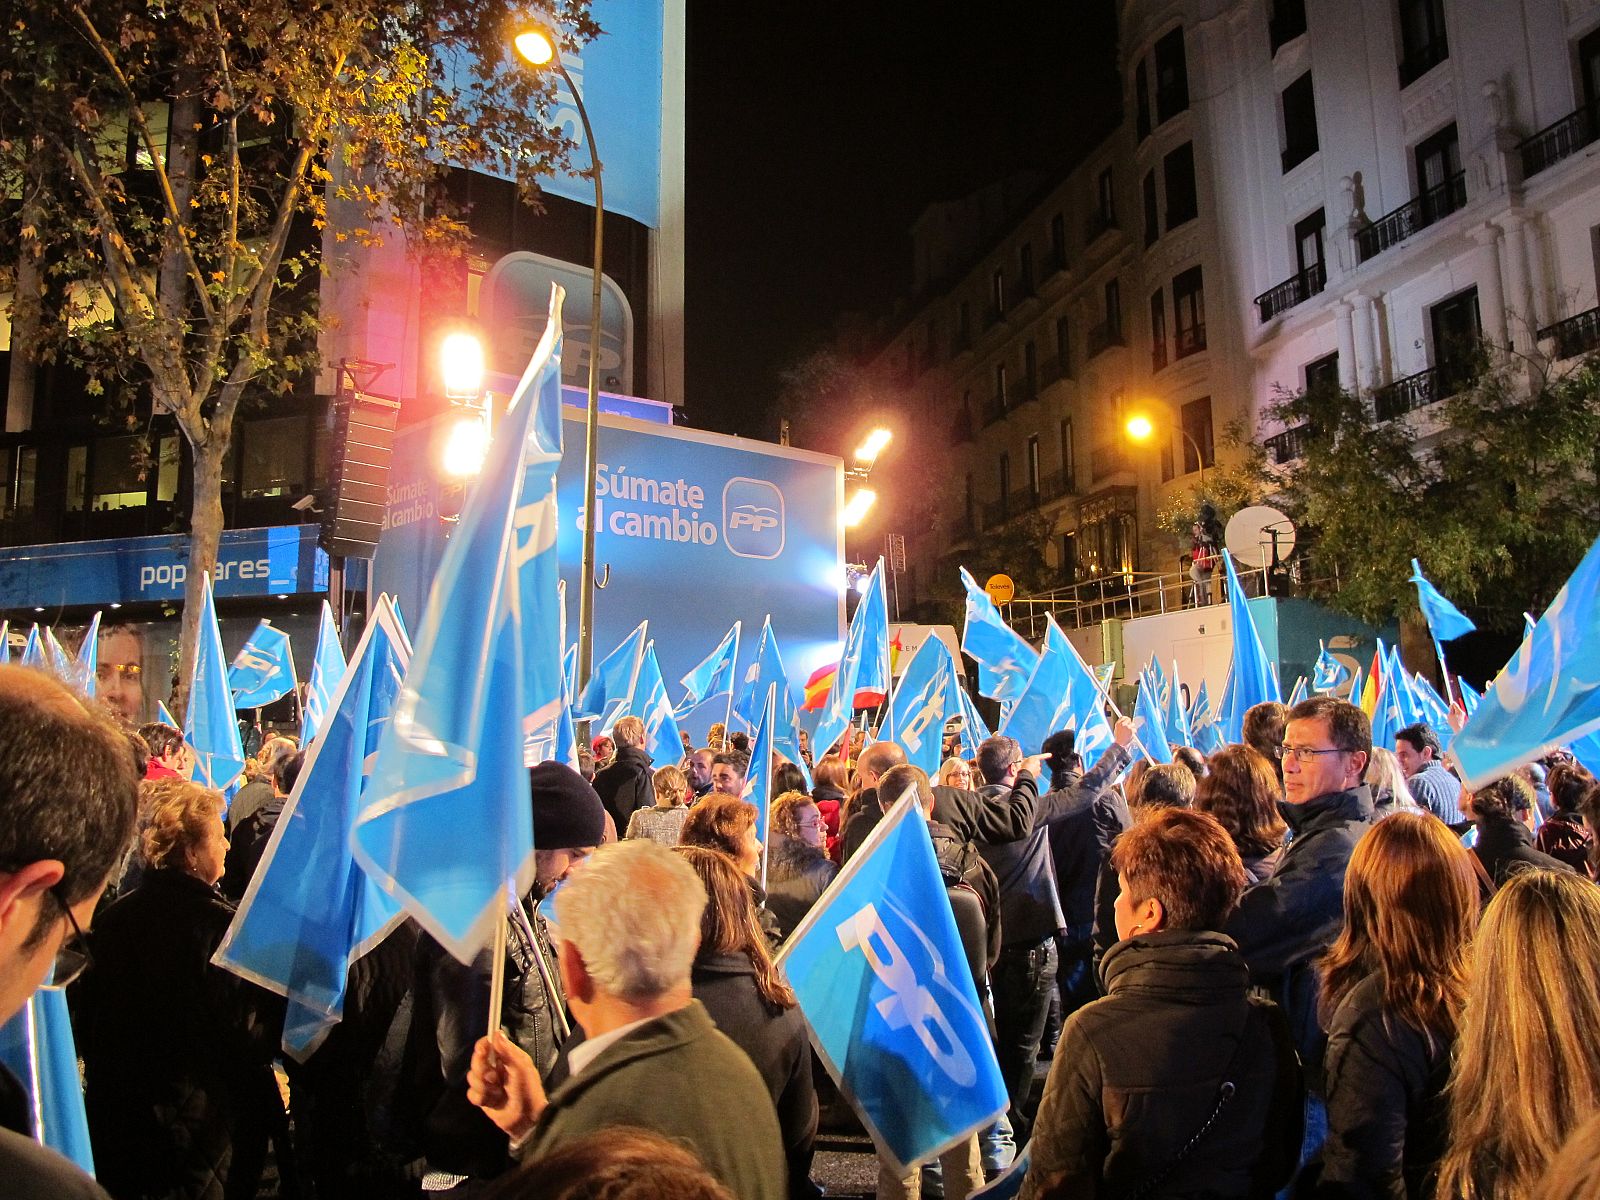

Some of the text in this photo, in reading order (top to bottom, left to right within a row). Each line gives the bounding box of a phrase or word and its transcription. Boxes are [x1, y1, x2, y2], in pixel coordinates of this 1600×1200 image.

[596, 463, 705, 509] Súmate
[391, 499, 433, 528] cambio
[609, 508, 718, 546] cambio
[729, 511, 778, 531] PP
[139, 558, 272, 592] popares
[835, 902, 977, 1088] PP
